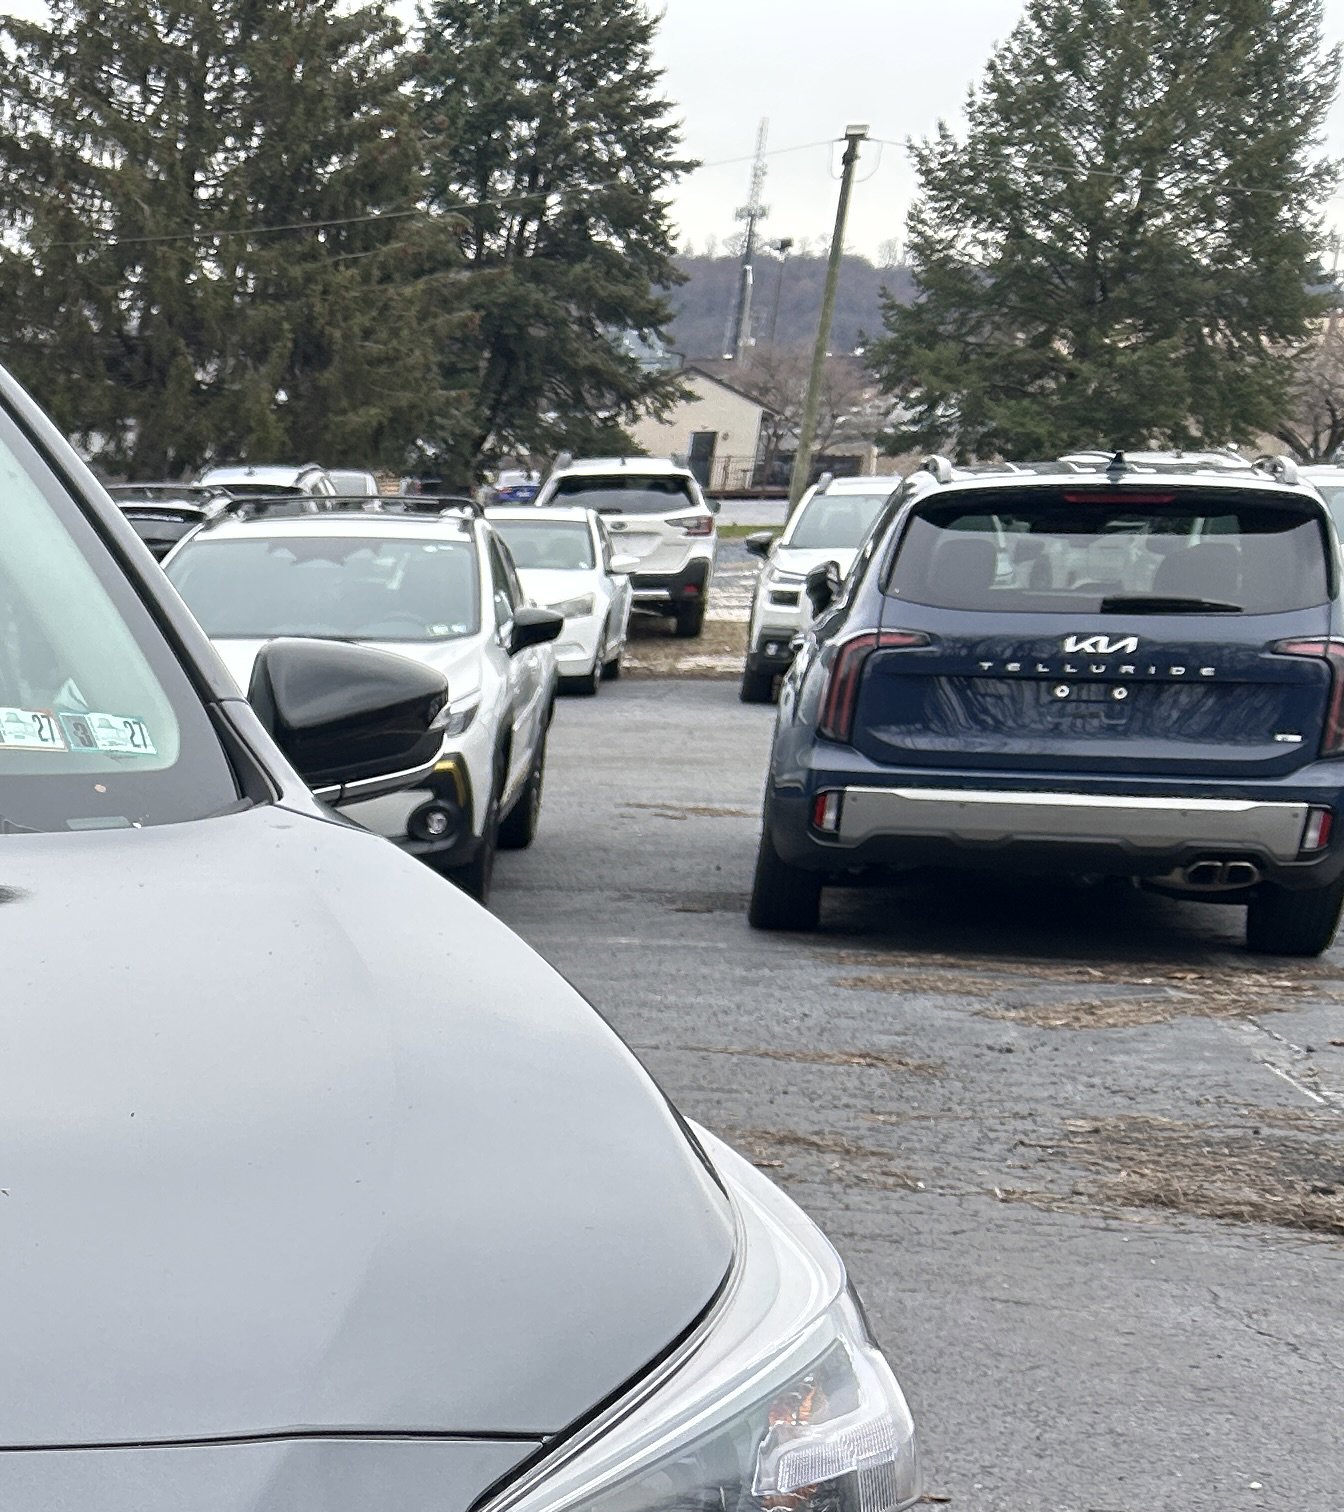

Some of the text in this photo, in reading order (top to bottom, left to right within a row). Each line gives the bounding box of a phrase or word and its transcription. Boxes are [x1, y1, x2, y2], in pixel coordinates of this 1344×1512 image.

[978, 661, 1216, 676] TELLURIDE
[31, 714, 56, 743] 27
[123, 720, 148, 749] 27
